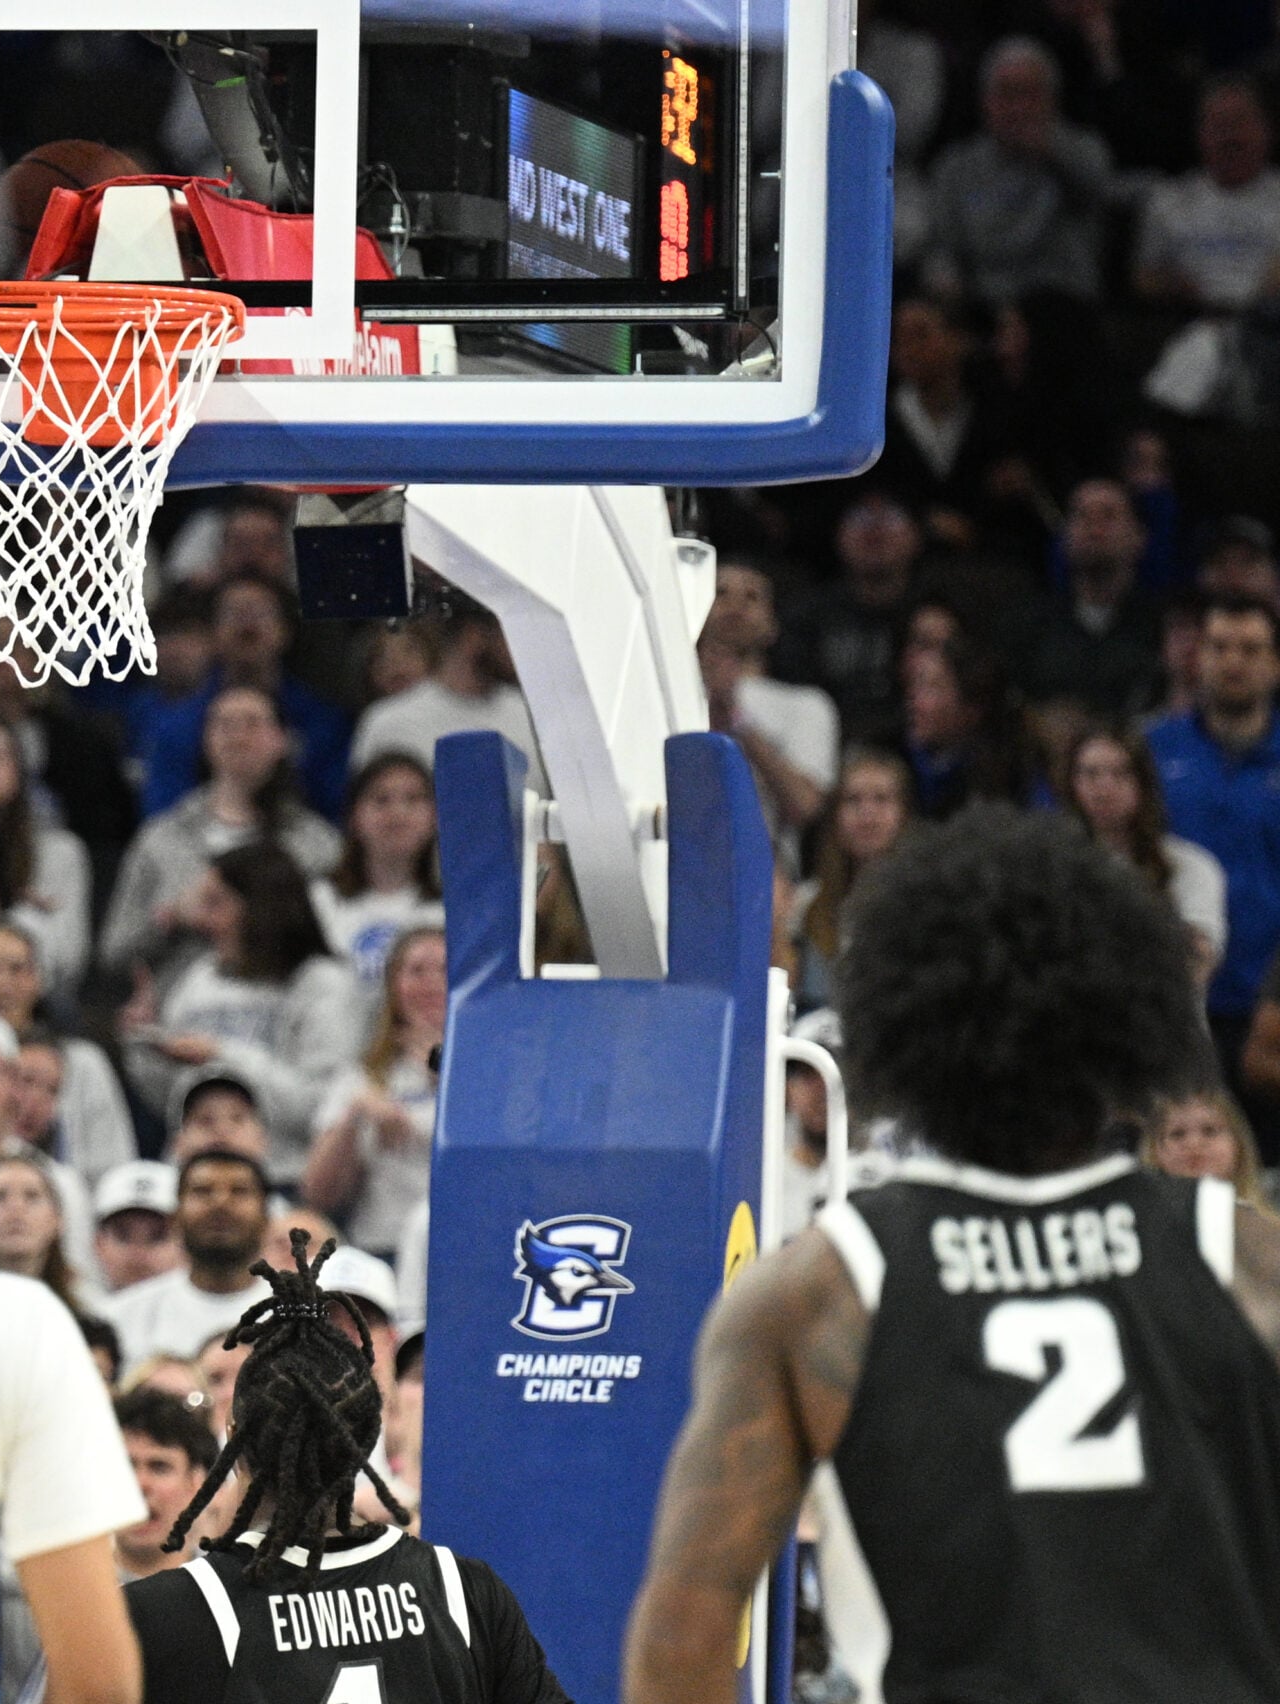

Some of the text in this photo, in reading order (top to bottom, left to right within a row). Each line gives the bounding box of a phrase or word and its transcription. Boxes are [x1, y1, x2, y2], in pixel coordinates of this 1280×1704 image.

[538, 166, 589, 243] WEST
[593, 190, 631, 263] ONE
[931, 1202, 1142, 1294] SELLERS
[496, 1353, 643, 1379] CHAMPIONS
[523, 1378, 615, 1403] CIRCLE
[982, 1297, 1145, 1493] 2
[268, 1582, 425, 1652] EDWARDS
